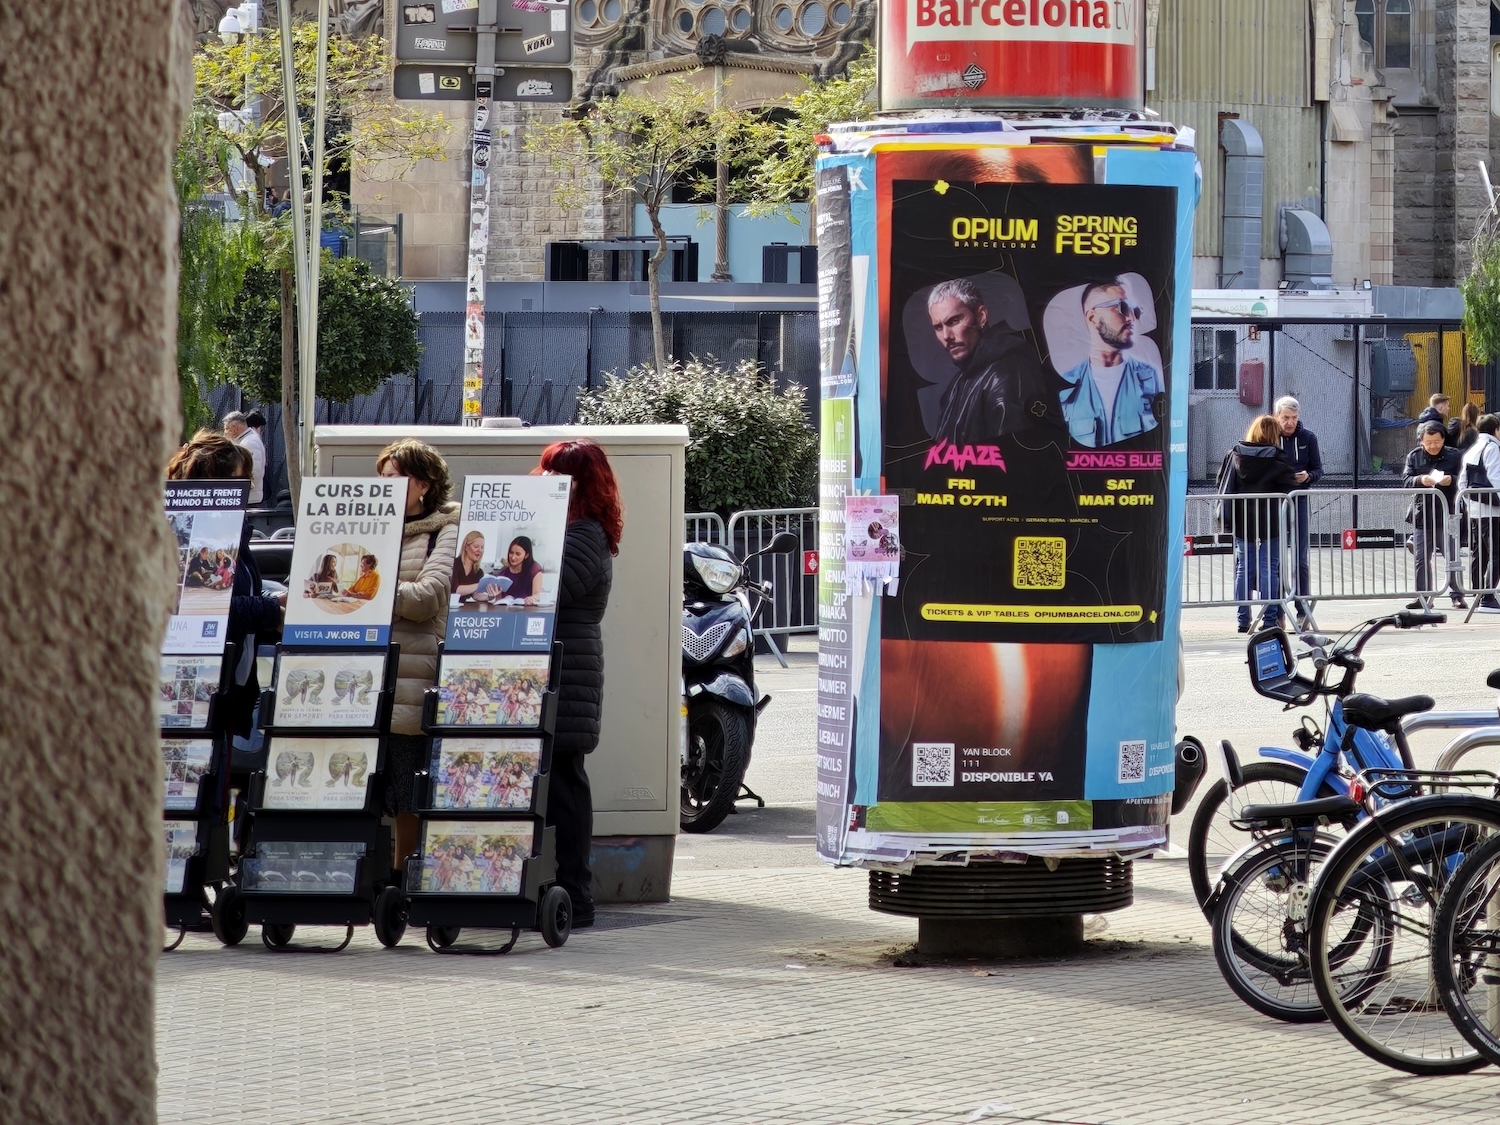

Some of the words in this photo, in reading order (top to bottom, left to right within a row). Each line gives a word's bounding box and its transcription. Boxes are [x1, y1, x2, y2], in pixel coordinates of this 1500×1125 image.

[952, 217, 1039, 242] OPIUM
[1056, 214, 1138, 234] SPRING
[954, 241, 1037, 249] BARCELONA
[1055, 233, 1137, 255] FEST
[924, 436, 1007, 474] KAAZE
[1066, 452, 1127, 468] JONAS
[1129, 452, 1162, 468] BLUE
[948, 478, 976, 490] FRI
[1106, 479, 1135, 491] SAT
[177, 489, 211, 498] HACERLE
[212, 488, 242, 497] FRENTE
[315, 483, 364, 498] CURS
[369, 484, 393, 497] DE
[470, 482, 512, 499] FREE
[172, 498, 202, 507] MUNDO
[203, 498, 214, 506] EN
[215, 498, 241, 507] CRISIS
[468, 499, 527, 511] PERSONAL
[917, 493, 955, 505] MAR
[959, 494, 1008, 507] 07TH
[1079, 494, 1116, 506] MAR
[1118, 494, 1154, 506] 08TH
[306, 502, 330, 517] LA
[335, 499, 397, 516] BÍBLIA
[467, 511, 497, 522] BIBLE
[499, 511, 536, 522] STUDY
[310, 520, 390, 535] GRATUÏT
[833, 592, 847, 606] ZIP
[926, 608, 964, 616] TICKETS
[1034, 610, 1141, 618] OPIUMBARCELONA.COM
[453, 617, 502, 628] REQUEST
[530, 620, 542, 628] JW
[294, 630, 324, 640] VISITA
[325, 630, 360, 640] JW.ORG
[453, 629, 460, 639] A
[463, 629, 489, 639] VISIT
[962, 748, 980, 756] YAN
[982, 748, 1011, 756] BLOCK
[962, 771, 1035, 783] DISPONIBLE
[1037, 771, 1054, 782] YA
